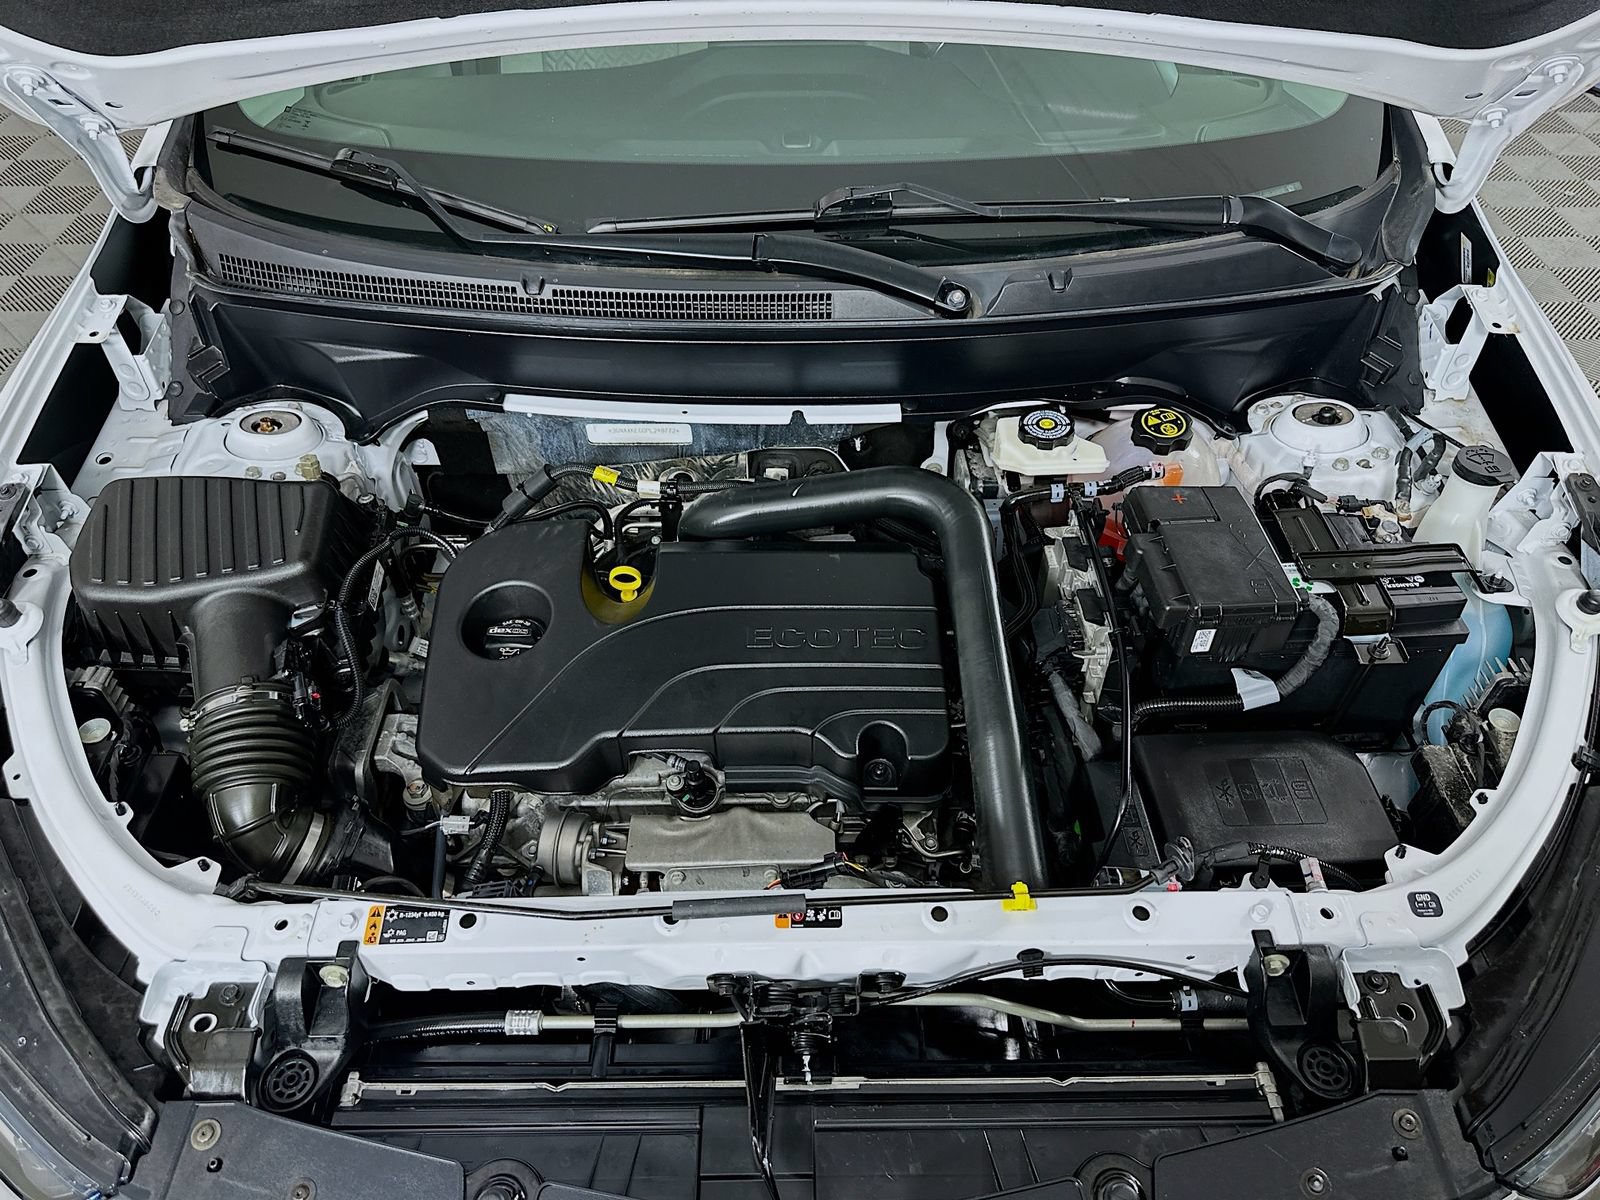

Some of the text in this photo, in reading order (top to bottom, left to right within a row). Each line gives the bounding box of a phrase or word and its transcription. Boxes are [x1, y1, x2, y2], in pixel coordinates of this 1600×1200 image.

[488, 626, 529, 635] dexos
[746, 627, 926, 649] ECOTEC
[1415, 893, 1431, 901] GND
